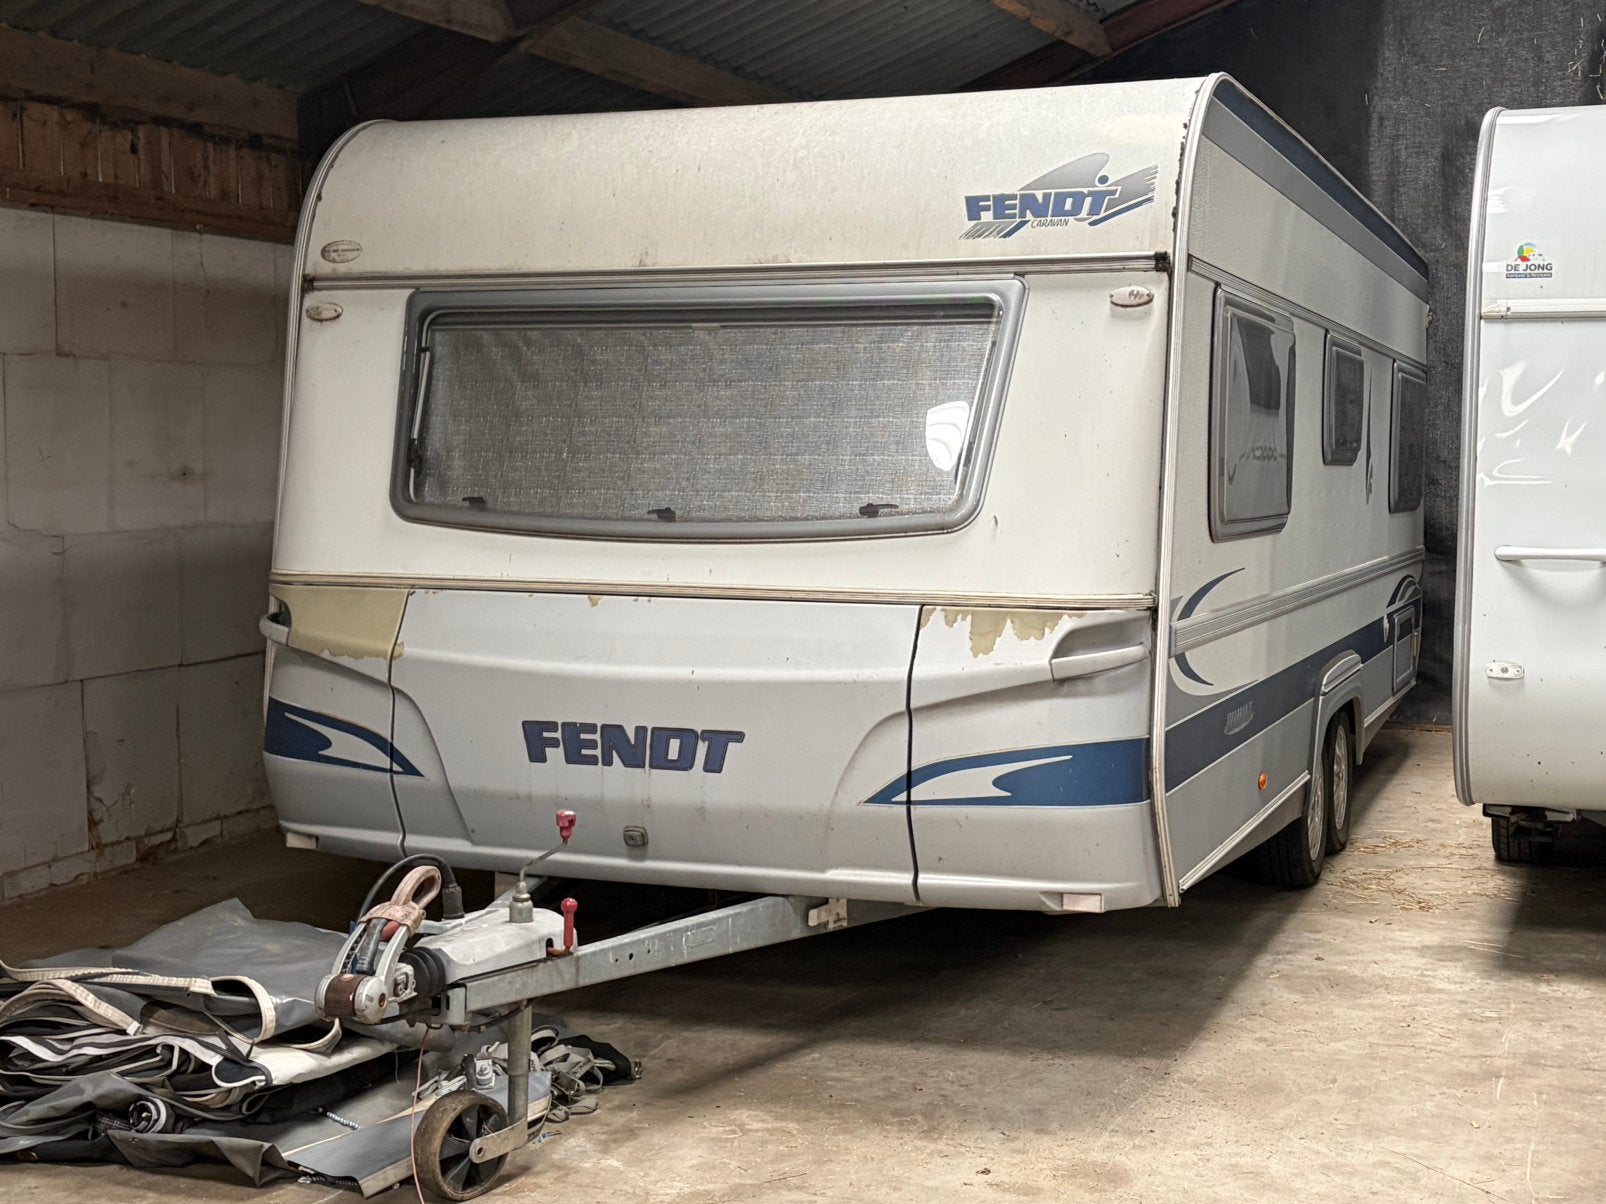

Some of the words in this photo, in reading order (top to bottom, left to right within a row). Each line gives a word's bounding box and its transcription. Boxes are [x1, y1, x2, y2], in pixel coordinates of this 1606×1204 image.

[965, 188, 1118, 221] FENDT
[1031, 218, 1070, 228] CARAVAN
[1506, 263, 1520, 272] DE
[1522, 263, 1553, 272] JONG
[522, 720, 745, 773] FENDT
